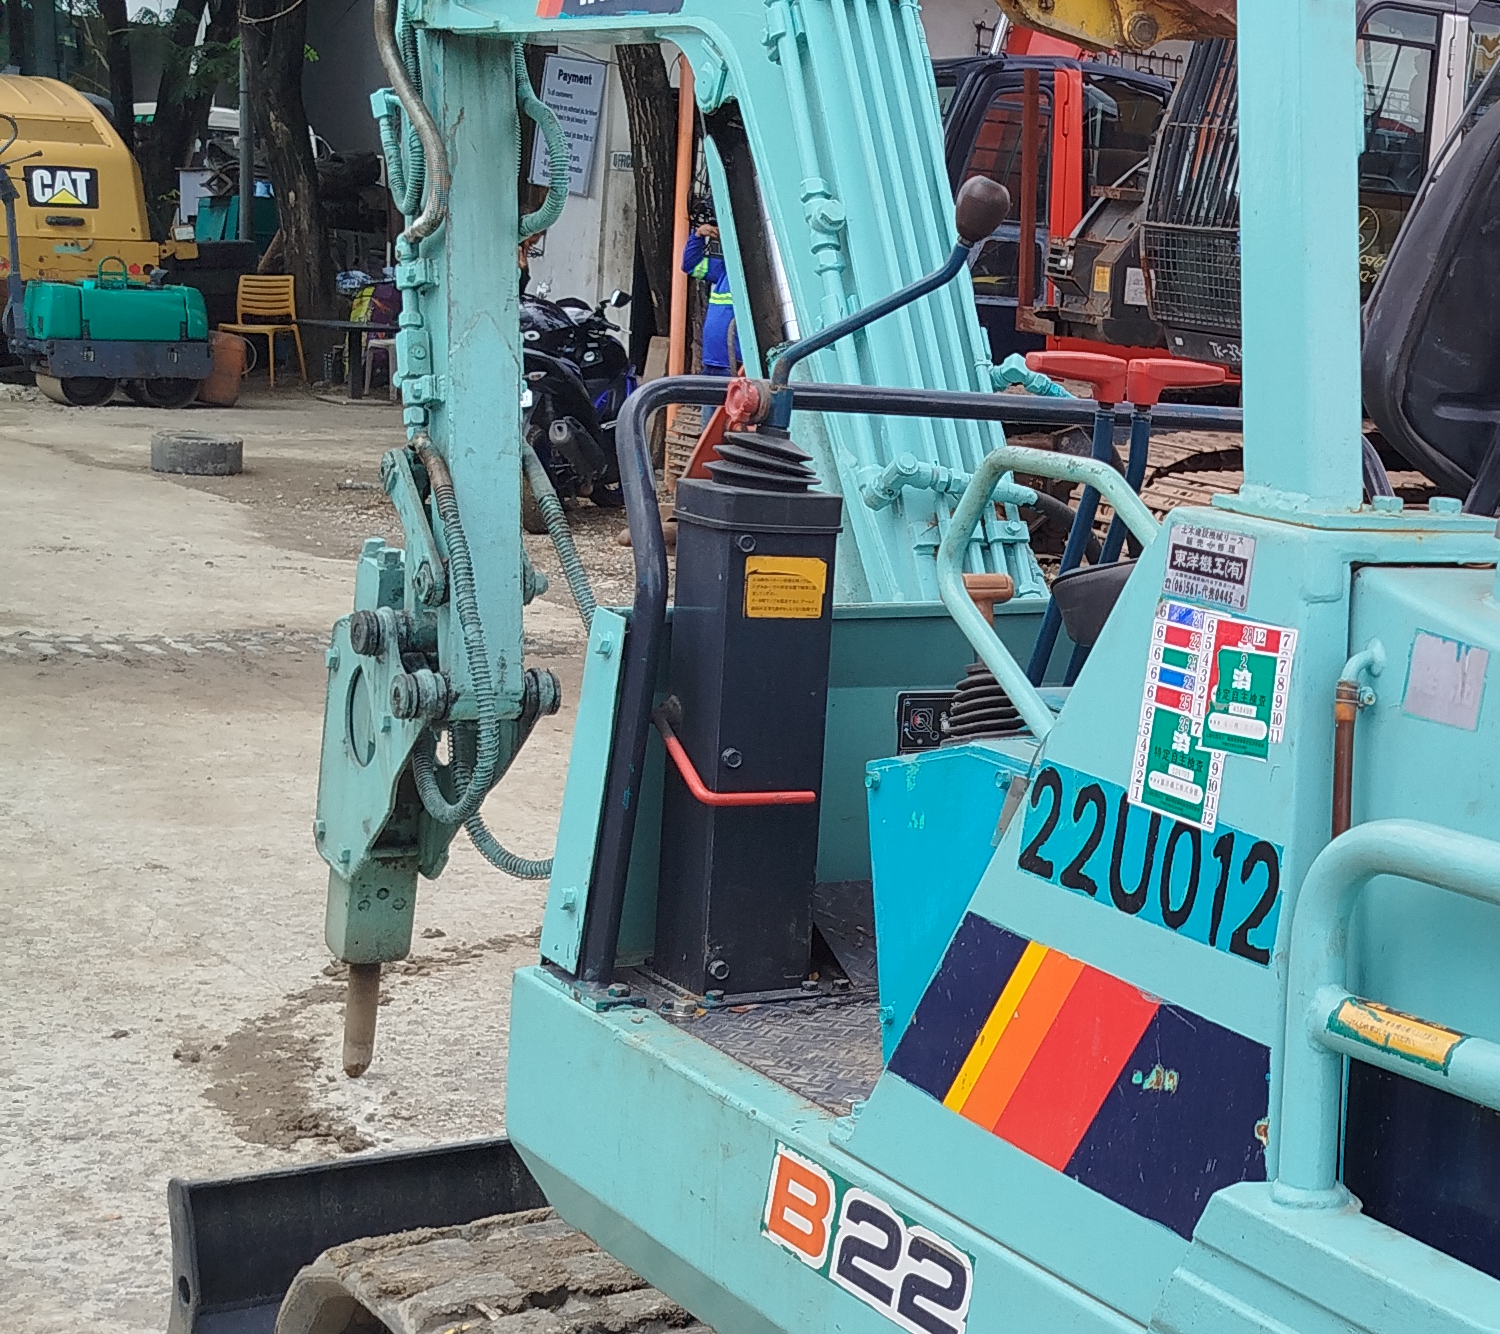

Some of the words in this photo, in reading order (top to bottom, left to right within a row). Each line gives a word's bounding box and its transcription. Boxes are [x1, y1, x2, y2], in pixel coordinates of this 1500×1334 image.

[557, 69, 593, 86] Payment
[613, 153, 631, 169] OFFIC
[32, 169, 91, 205] CAT
[1208, 340, 1242, 362] TK-33
[1157, 625, 1164, 639] 6
[1207, 618, 1215, 633] 6
[1204, 636, 1212, 650] 5
[1254, 630, 1267, 645] 12
[1282, 633, 1291, 648] 7
[1154, 647, 1161, 661] 6
[1202, 652, 1210, 667] 4
[1240, 653, 1248, 669] 2
[1279, 658, 1287, 673] 7
[1150, 667, 1158, 681] 6
[1200, 668, 1208, 683] 3
[1276, 676, 1285, 691] 8
[1147, 685, 1155, 699] 6
[1198, 684, 1206, 700] 2
[1274, 693, 1283, 709] 9
[1145, 706, 1153, 720] 6
[1196, 702, 1203, 717] 1
[1271, 711, 1282, 726] 10
[1142, 722, 1150, 736] 5
[1193, 721, 1202, 735] 7
[1269, 728, 1280, 744] 11
[1140, 738, 1148, 752] 4
[1137, 754, 1146, 768] 3
[1135, 770, 1144, 784] 2
[1211, 763, 1219, 778] 9
[1133, 786, 1140, 800] 1
[1208, 778, 1218, 793] 10
[1205, 795, 1215, 810] 11
[1202, 811, 1213, 826] 12
[1018, 767, 1280, 966] 22U012
